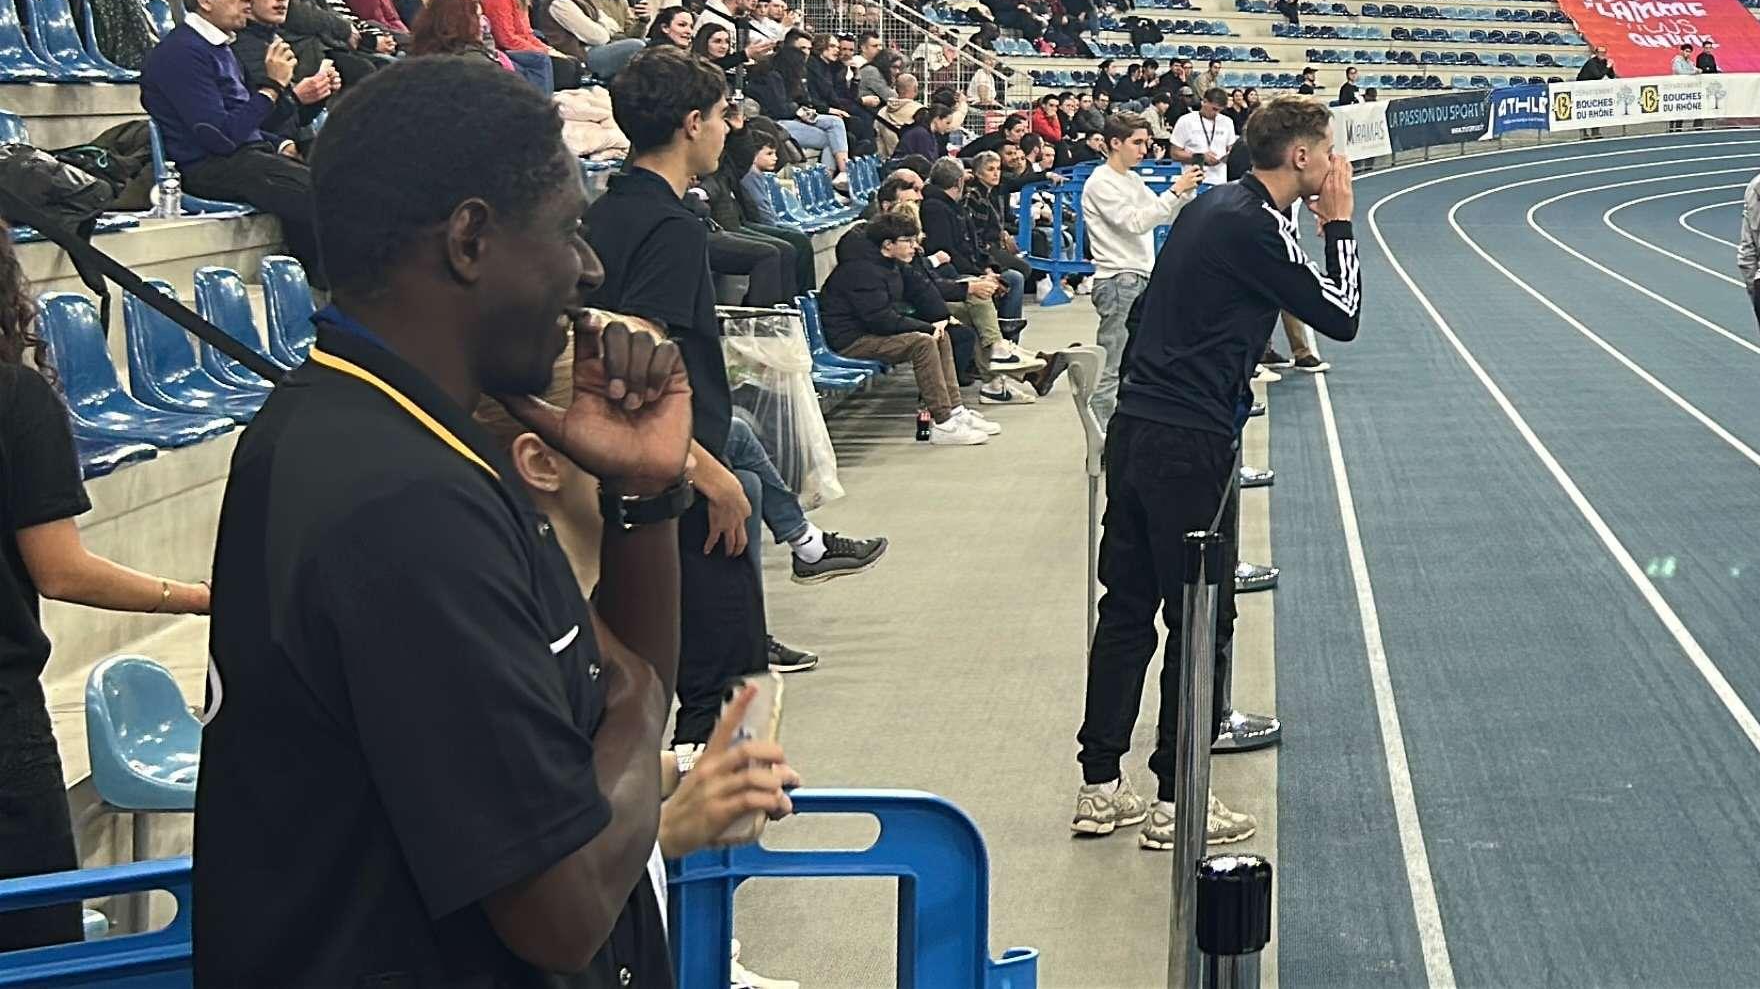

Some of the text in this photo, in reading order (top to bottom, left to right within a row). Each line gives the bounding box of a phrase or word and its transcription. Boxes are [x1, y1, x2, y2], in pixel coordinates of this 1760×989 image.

[1399, 108, 1435, 126] PASSION
[1436, 106, 1448, 122] DU
[1449, 103, 1479, 120] SPORT
